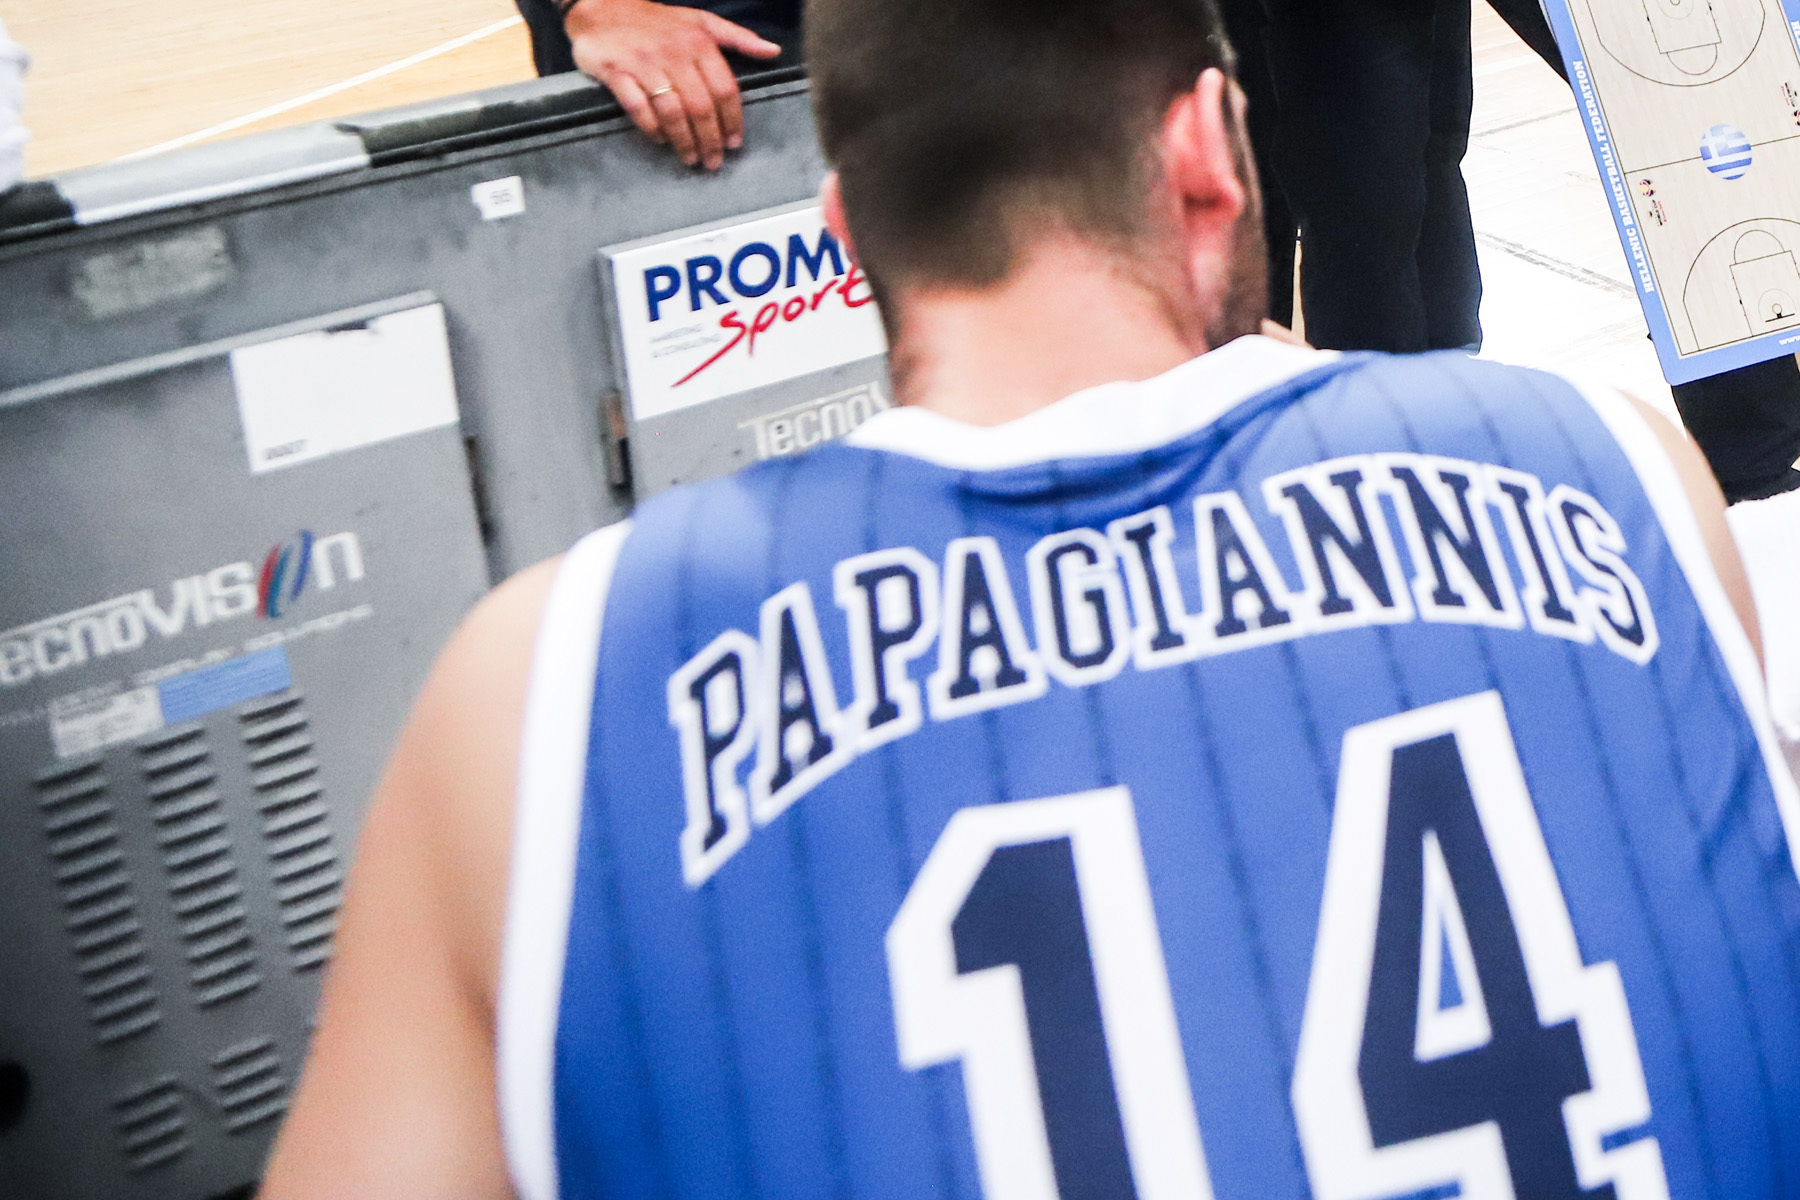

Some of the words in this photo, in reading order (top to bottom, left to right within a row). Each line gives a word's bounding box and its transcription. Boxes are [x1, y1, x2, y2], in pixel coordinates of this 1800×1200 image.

[1573, 59, 1609, 143] FEDERATION
[1599, 140, 1636, 230] BASKETBALL
[644, 226, 852, 322] PROM
[1625, 227, 1655, 293] HELLENIC
[666, 450, 1660, 890] PAPAGIANNIS
[885, 688, 1675, 1200] 14
